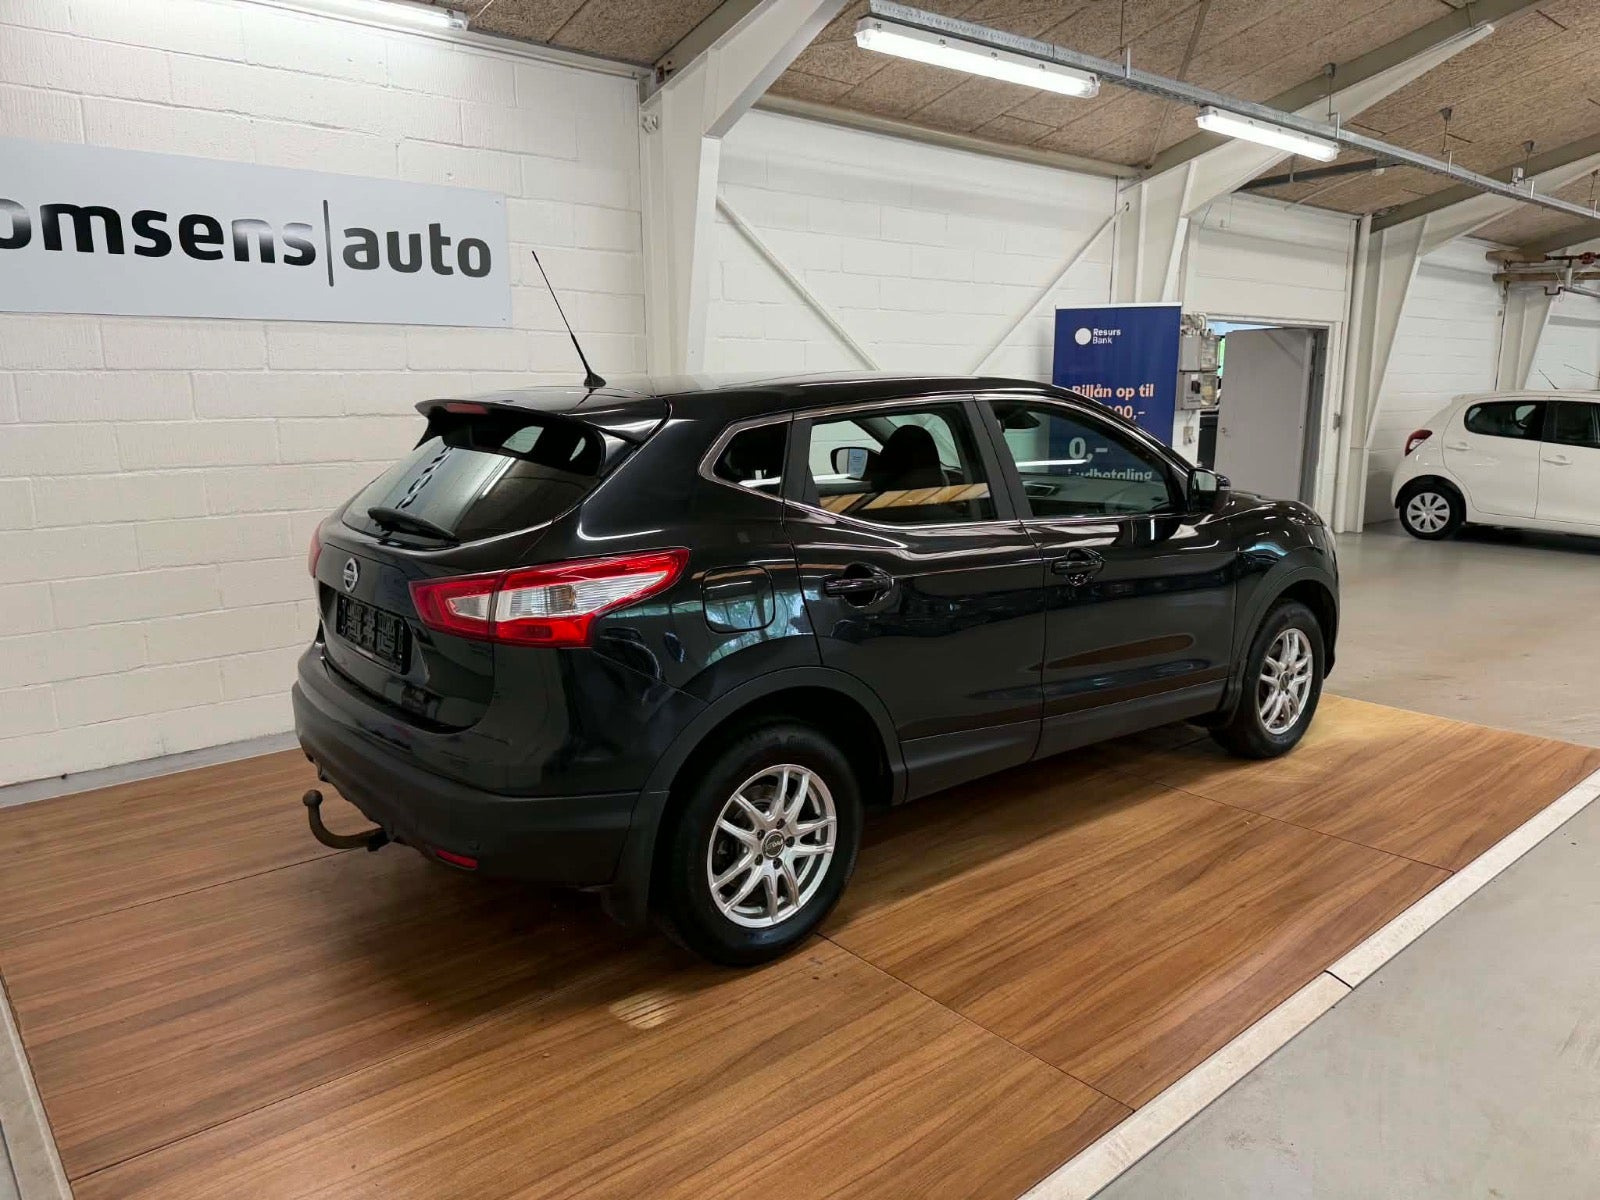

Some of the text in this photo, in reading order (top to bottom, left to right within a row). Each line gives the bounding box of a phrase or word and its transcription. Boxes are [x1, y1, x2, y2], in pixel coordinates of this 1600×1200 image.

[1092, 328, 1121, 336] Resurs
[1092, 336, 1113, 345] Bank
[1115, 387, 1135, 401] op
[1138, 383, 1155, 397] til
